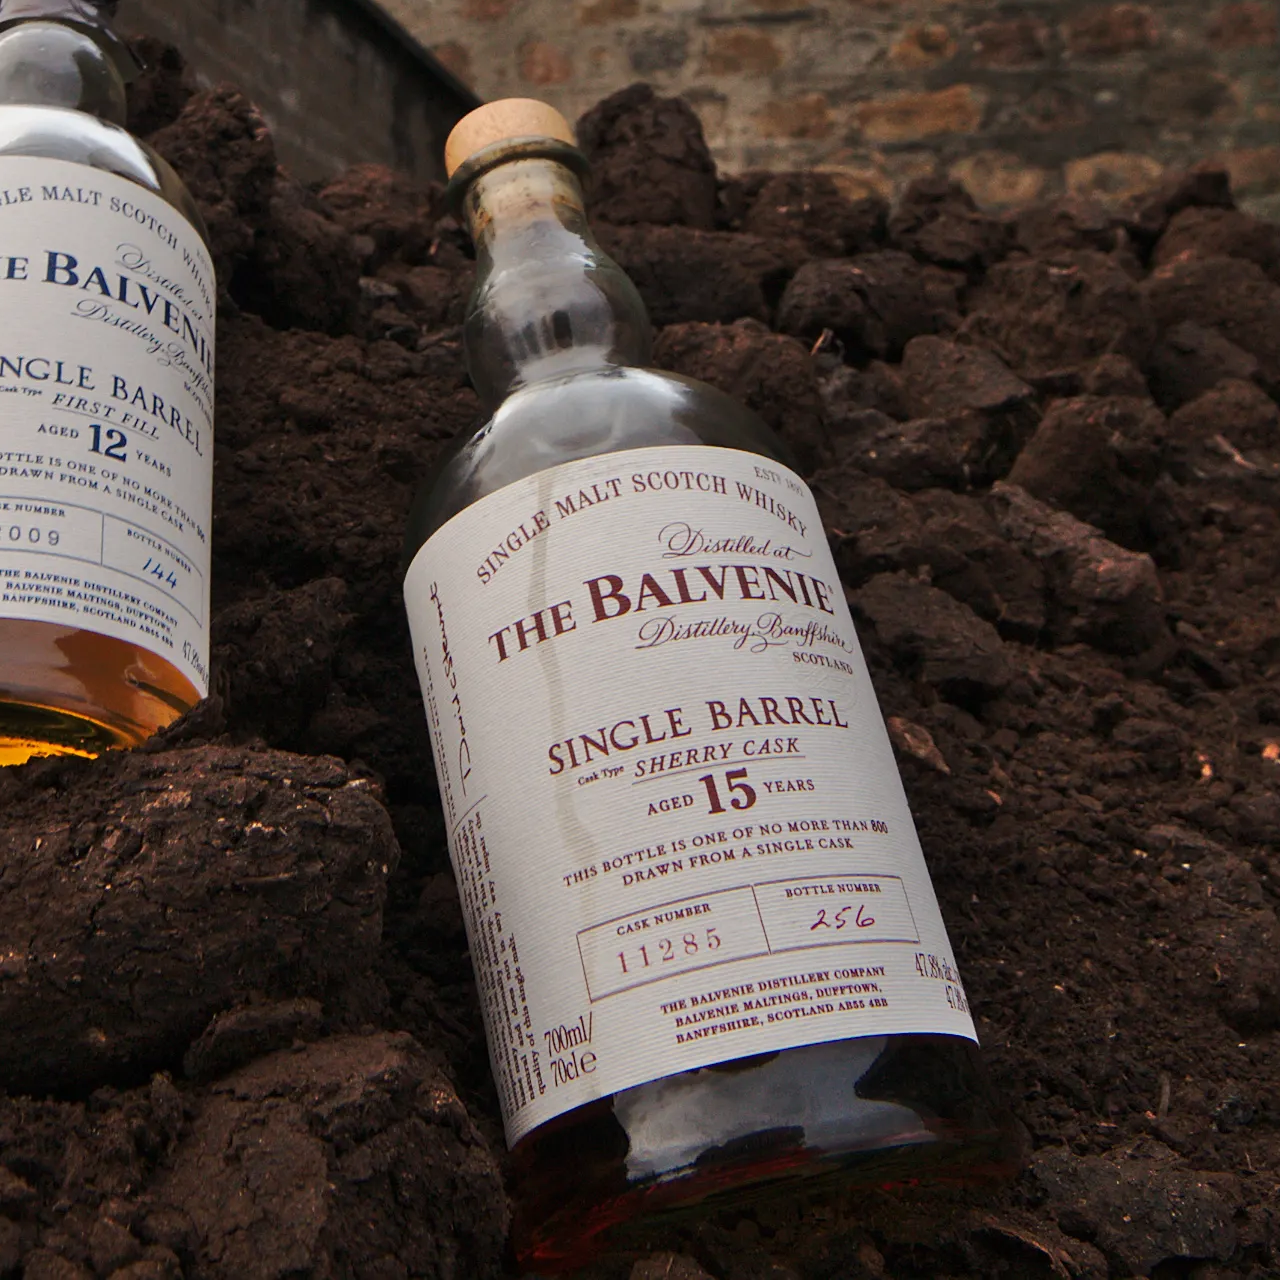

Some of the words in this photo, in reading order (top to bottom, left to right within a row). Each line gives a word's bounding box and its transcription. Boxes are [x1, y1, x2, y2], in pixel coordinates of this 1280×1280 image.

[41, 185, 101, 206] MALT
[110, 196, 178, 250] SCOTCH
[115, 242, 194, 307] Distilled
[52, 393, 116, 418] FIRST
[121, 412, 159, 439] FILL
[111, 374, 203, 457] BARREL
[37, 423, 79, 439] AGED
[87, 424, 128, 462] 12
[136, 449, 172, 477] YEARS
[49, 457, 62, 467] IS
[67, 460, 96, 475] ONE
[101, 469, 119, 481] OF
[123, 476, 140, 491] NO
[144, 486, 173, 510] MORE
[60, 473, 99, 490] FROM
[103, 485, 112, 495] A
[116, 488, 158, 515] SINGLE
[161, 510, 184, 533] CASK
[15, 504, 66, 517] NUMBER
[477, 510, 551, 584] SINGLE
[554, 478, 623, 519] MALT
[632, 471, 727, 495] SCOTCH
[735, 481, 807, 538] WHISKY
[127, 528, 162, 552] BOTTLE
[658, 521, 770, 559] Distilled
[6, 581, 63, 595] BALVENIE
[142, 558, 177, 589] 144
[25, 570, 80, 586] BALVENIE
[84, 581, 141, 608] DISTILLERY
[144, 601, 178, 627] COMPANY
[83, 605, 136, 628] SCOTLAND
[488, 600, 577, 663] THE
[582, 565, 834, 623] BALVENIE
[751, 612, 854, 653] Banffshire
[792, 652, 853, 675] SCOTLAND
[548, 708, 692, 775] SINGLE
[705, 697, 849, 731] BARREL
[600, 766, 624, 778] Type
[634, 742, 733, 778] SHERRY
[744, 737, 800, 756] CASK
[648, 794, 694, 816] AGED
[699, 767, 757, 814] 15
[763, 779, 815, 793] YEARS
[563, 865, 598, 887] THIS
[602, 844, 667, 872] BOTTLE
[672, 839, 687, 852] IS
[692, 831, 727, 846] ONE
[732, 826, 753, 839] OF
[760, 823, 782, 836] NO
[787, 820, 829, 833] MORE
[832, 819, 868, 832] THAN
[622, 860, 683, 885] DRAWN
[689, 849, 736, 868] FROM
[741, 847, 753, 859] A
[756, 838, 814, 855] SINGLE
[818, 837, 854, 849] CASK
[785, 884, 834, 898] BOTTLE
[837, 883, 882, 893] NUMBER
[616, 918, 650, 936] CASK
[654, 903, 711, 925] NUMBER
[810, 904, 875, 930] 256
[617, 927, 721, 973] 11285
[660, 999, 687, 1015] THE
[690, 983, 754, 1007] BALVENIE
[758, 970, 830, 992] DISTILLERY
[834, 966, 886, 979] COMPANY
[767, 1003, 833, 1023] SCOTLAND
[676, 1003, 739, 1027] BALVENIE
